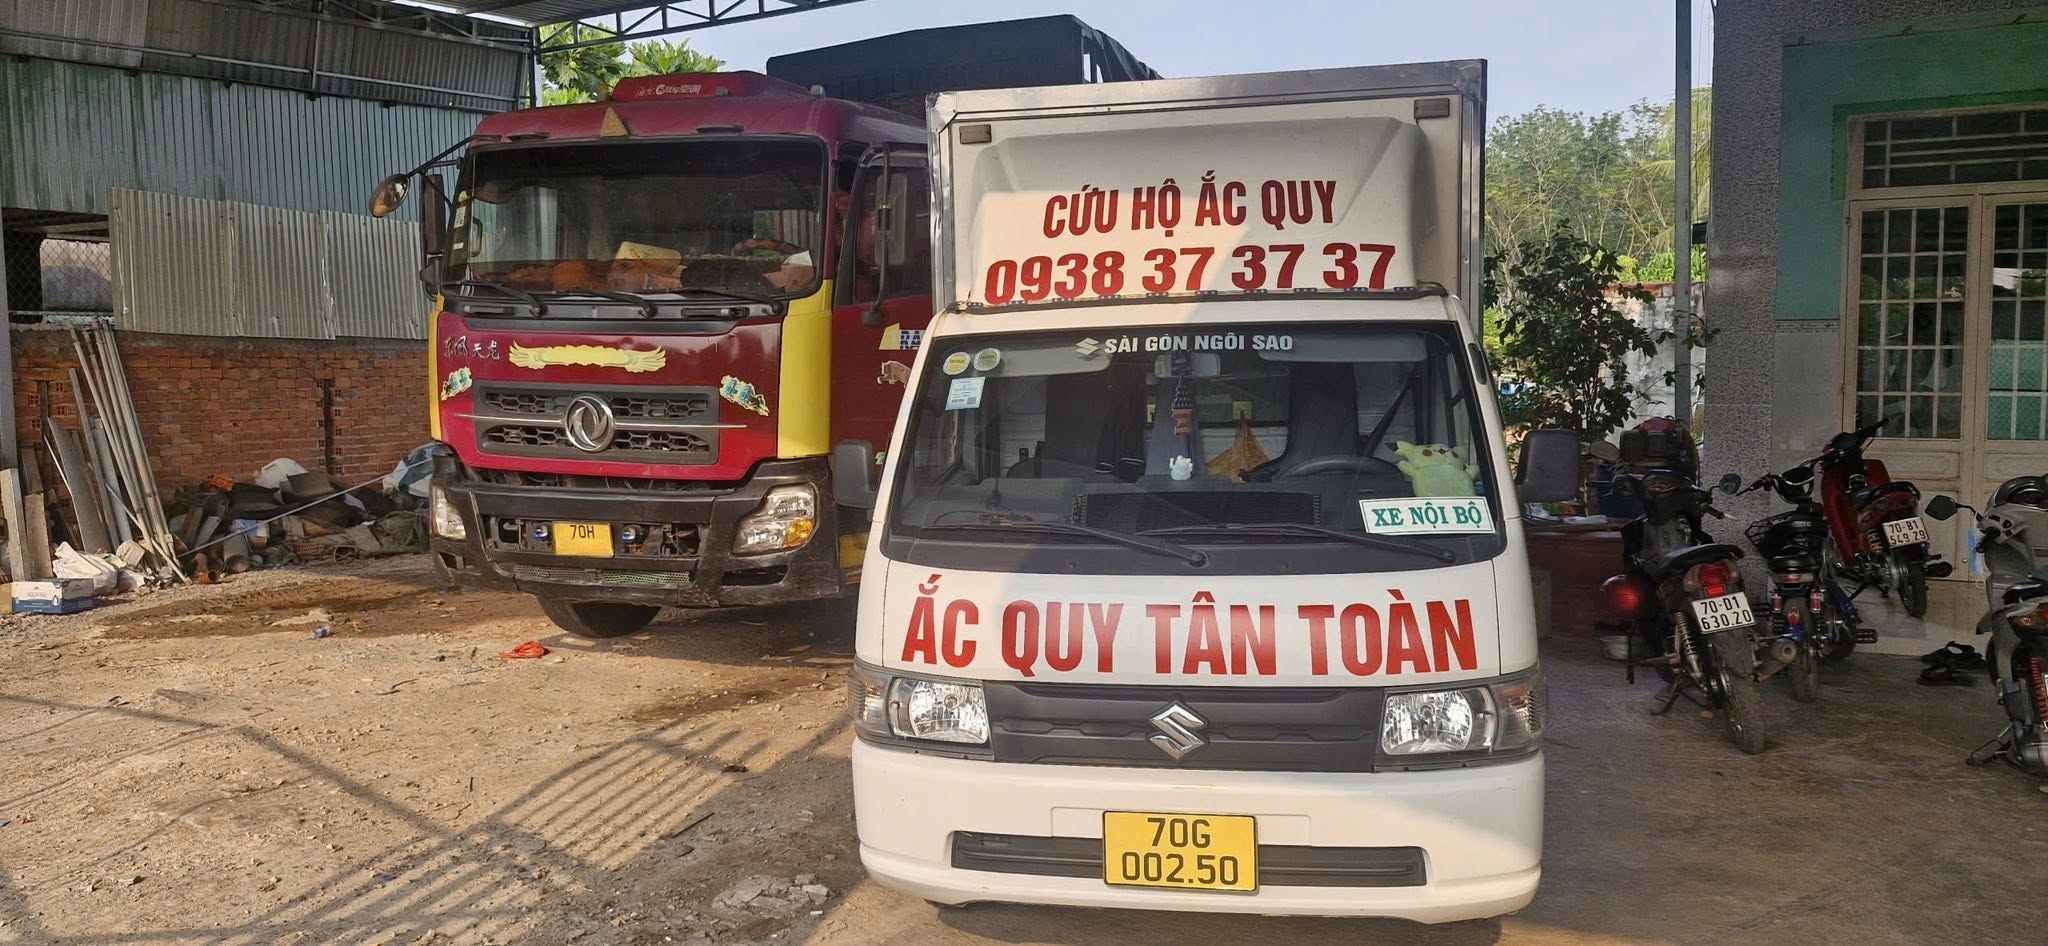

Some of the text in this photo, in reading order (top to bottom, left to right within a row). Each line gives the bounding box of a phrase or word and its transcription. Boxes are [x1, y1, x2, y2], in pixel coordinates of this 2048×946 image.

[1043, 170, 1337, 239] CỨU HỘ ẮC QUY
[984, 242, 1397, 306] 0938 37 37 37
[1104, 332, 1293, 354] SÀI GÒN NGÔI SAO
[1372, 500, 1482, 529] XE NỘI BỘ
[1889, 519, 1919, 534] 70-B1
[569, 524, 595, 540] 70H
[1700, 596, 1740, 615] 70-D1
[1700, 609, 1752, 630] 630.20
[901, 573, 1478, 678] ẮC QUY TÂN TOÀN
[1147, 817, 1211, 849] 70G
[1121, 851, 1239, 886] 002.50
